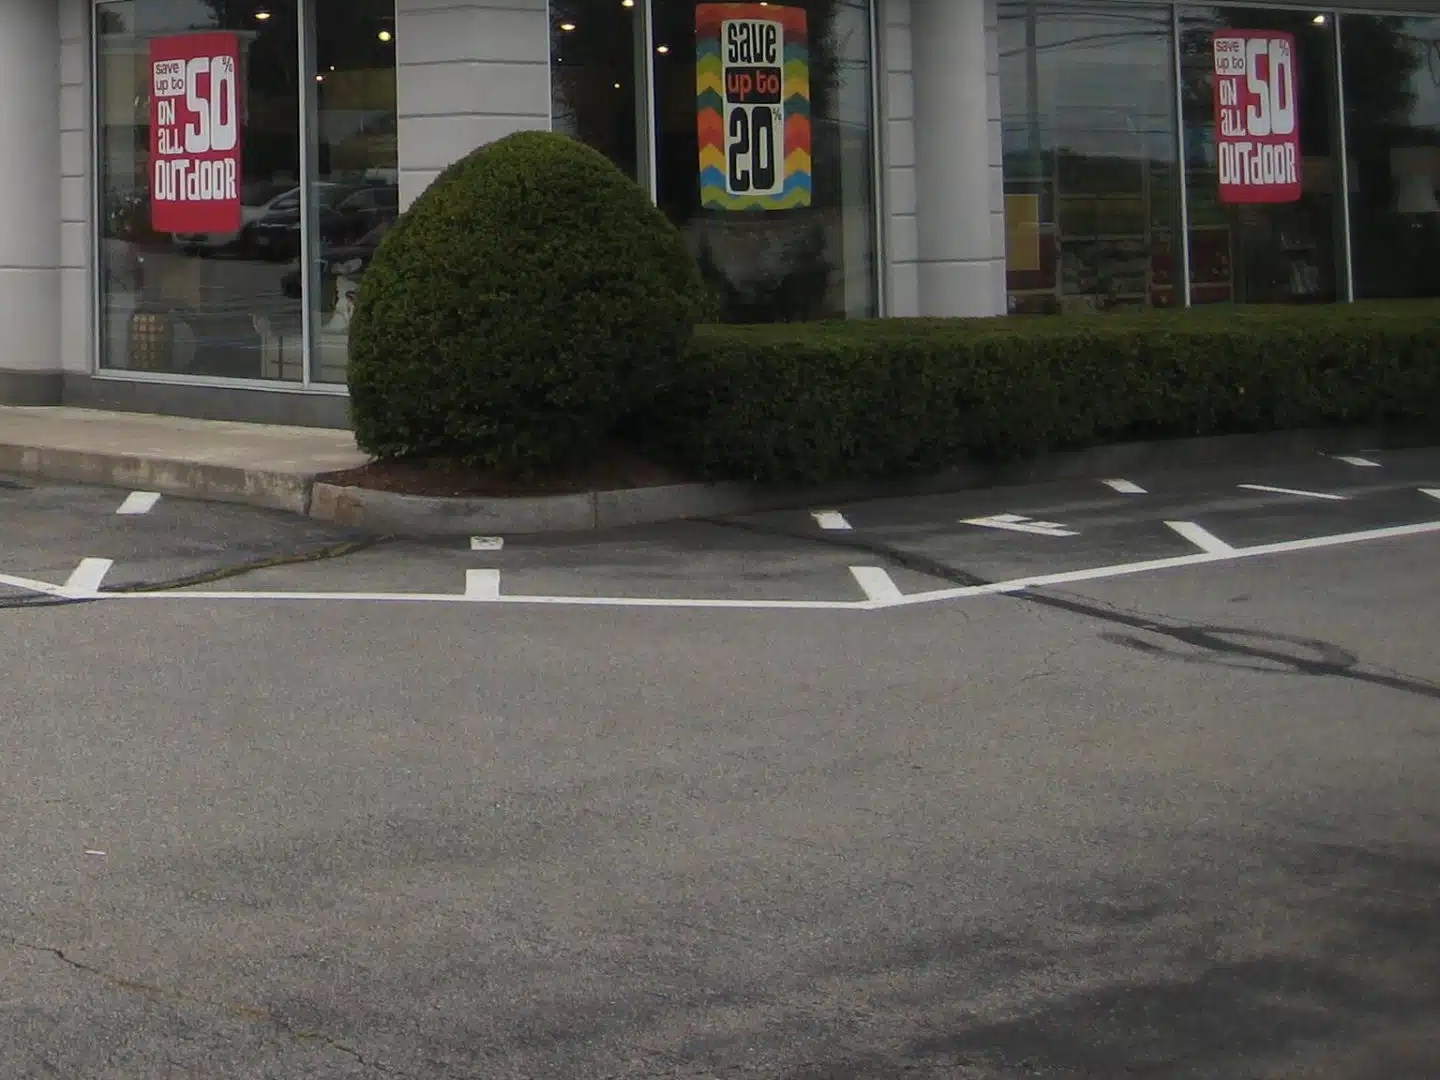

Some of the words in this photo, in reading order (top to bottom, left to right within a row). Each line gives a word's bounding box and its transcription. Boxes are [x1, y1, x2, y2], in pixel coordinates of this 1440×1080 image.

[727, 22, 777, 64] save
[1216, 40, 1240, 53] save
[156, 61, 180, 75] save
[1217, 58, 1230, 74] up
[1231, 56, 1245, 69] to
[156, 78, 170, 95] up
[171, 76, 185, 91] to
[727, 73, 753, 102] up
[756, 72, 780, 95] to
[1219, 78, 1237, 107] ON
[158, 98, 176, 127] ON
